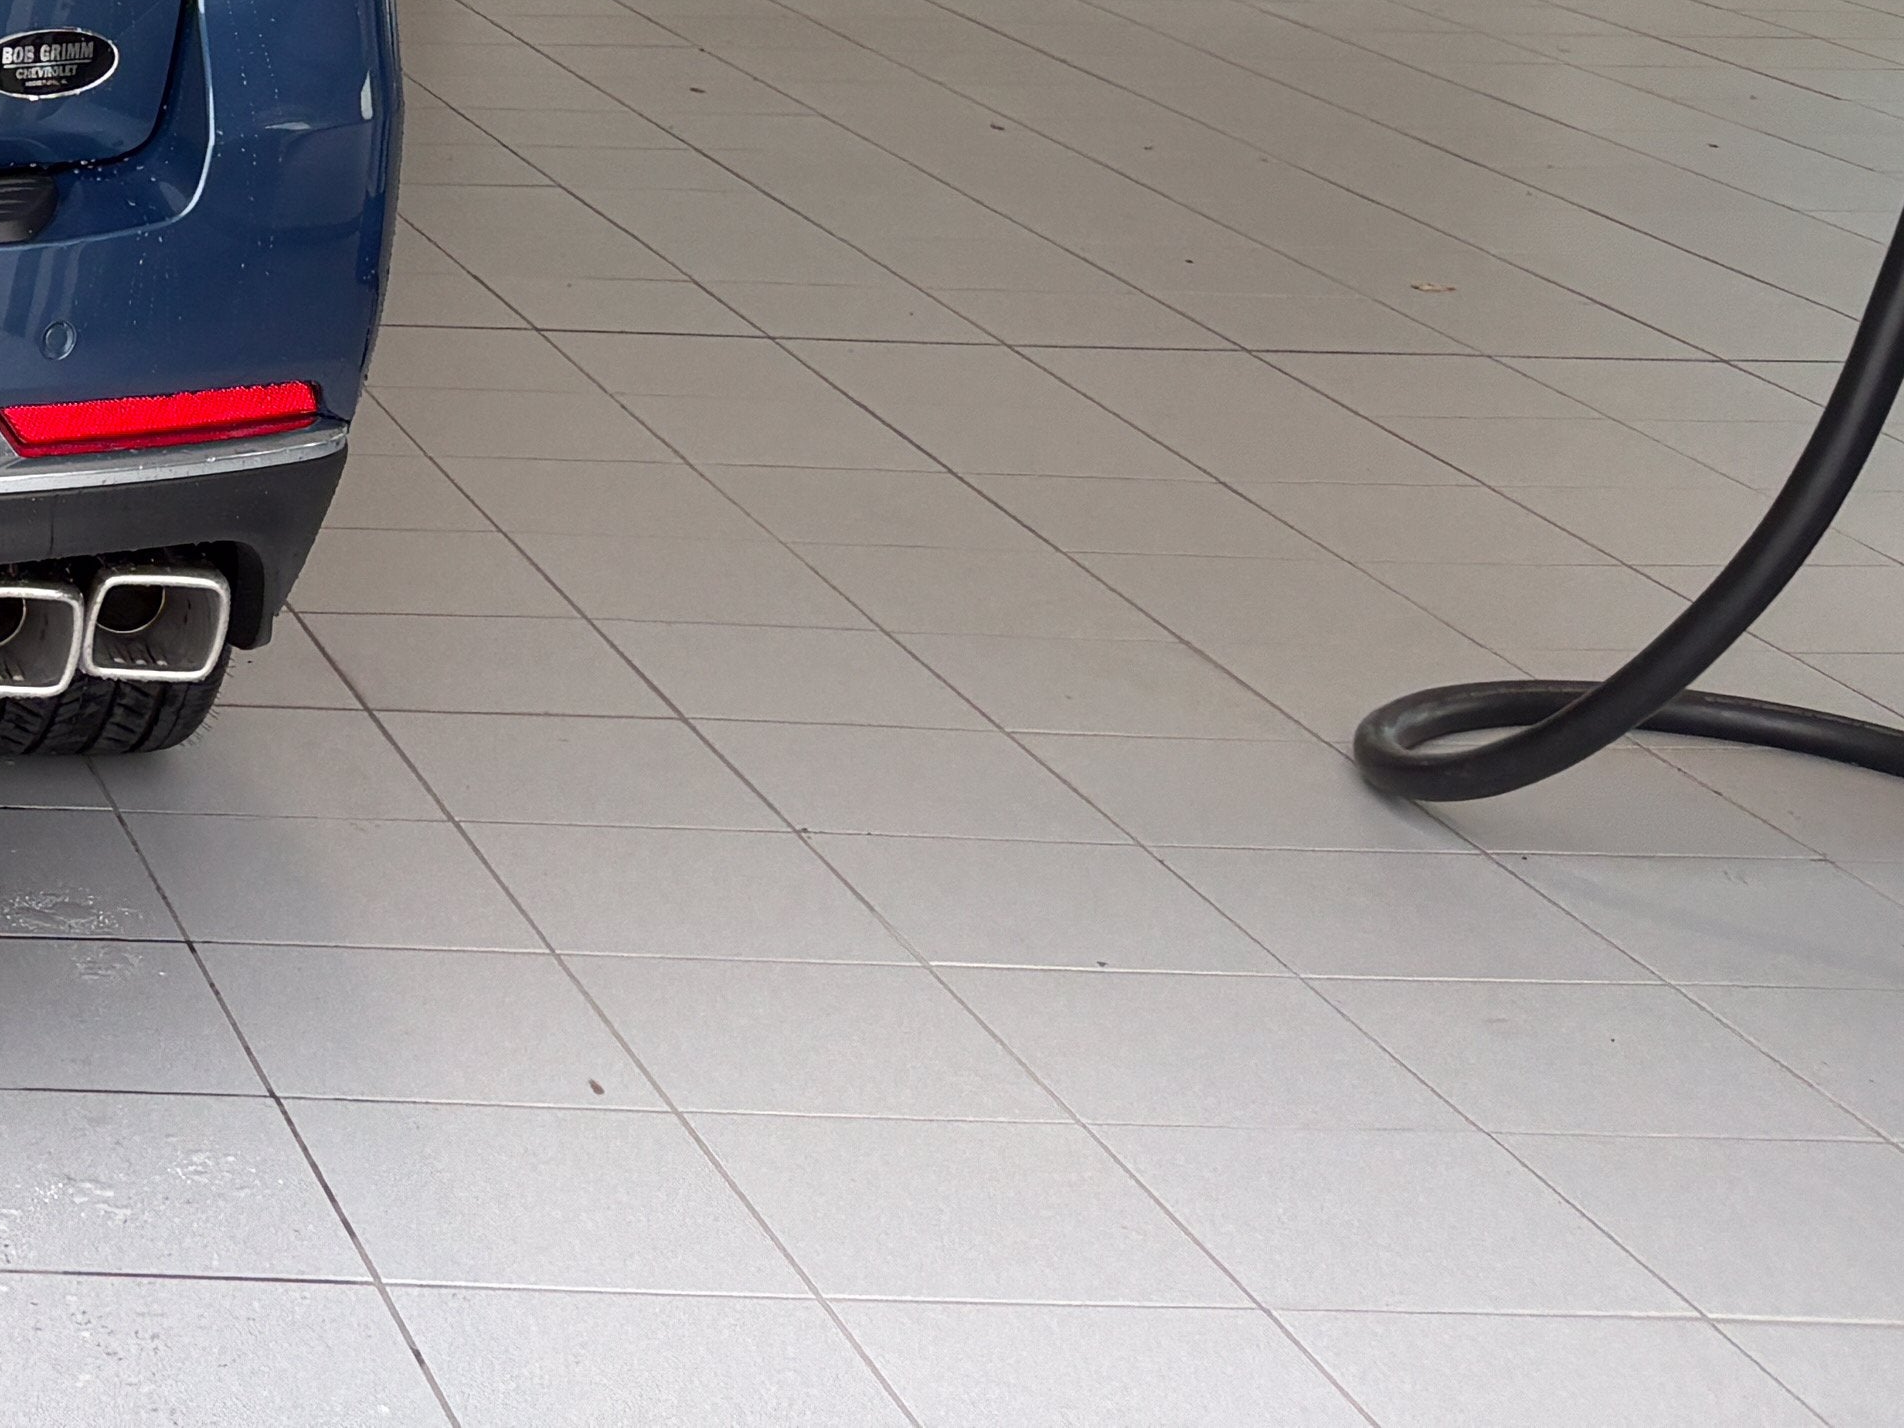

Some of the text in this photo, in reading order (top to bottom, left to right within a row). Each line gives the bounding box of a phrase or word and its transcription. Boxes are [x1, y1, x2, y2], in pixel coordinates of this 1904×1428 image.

[2, 41, 94, 64] BOB GRIMM
[16, 65, 77, 79] CHEVROLET
